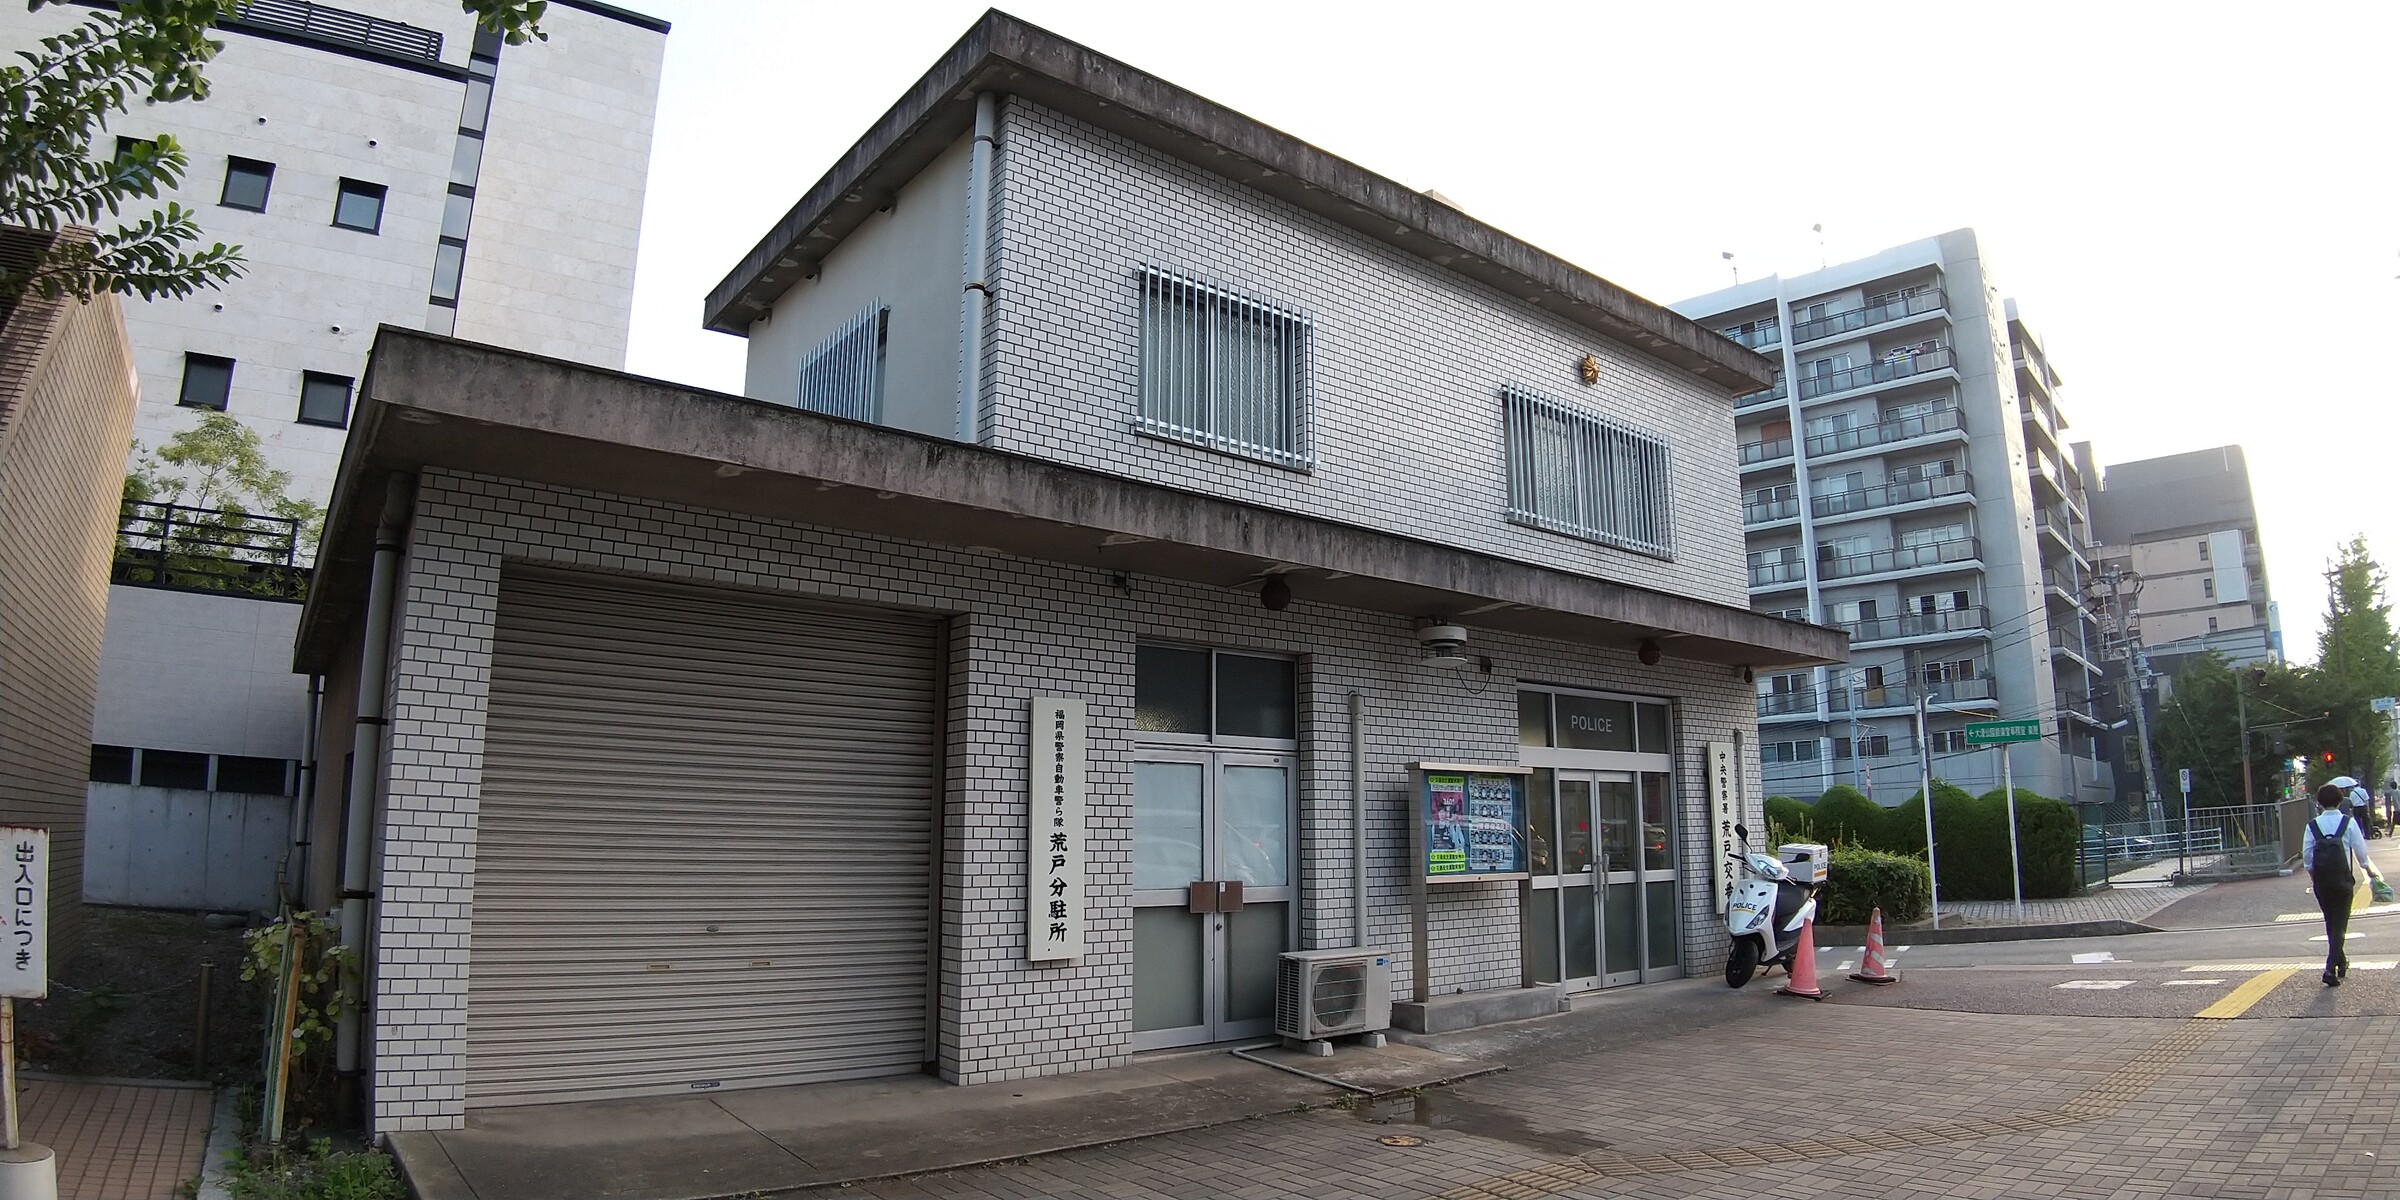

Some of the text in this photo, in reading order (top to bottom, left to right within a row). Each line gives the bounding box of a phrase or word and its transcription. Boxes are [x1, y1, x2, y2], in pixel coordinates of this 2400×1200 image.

[1571, 715, 1613, 733] POLICE
[1718, 751, 1729, 815] 中央警察署
[1048, 709, 1068, 942] 福岡県警察自動車警ら隊 荒戸分駐所
[1813, 862, 1827, 871] POLICE
[14, 841, 34, 971] 出入口につき
[1732, 902, 1758, 911] POLICE
